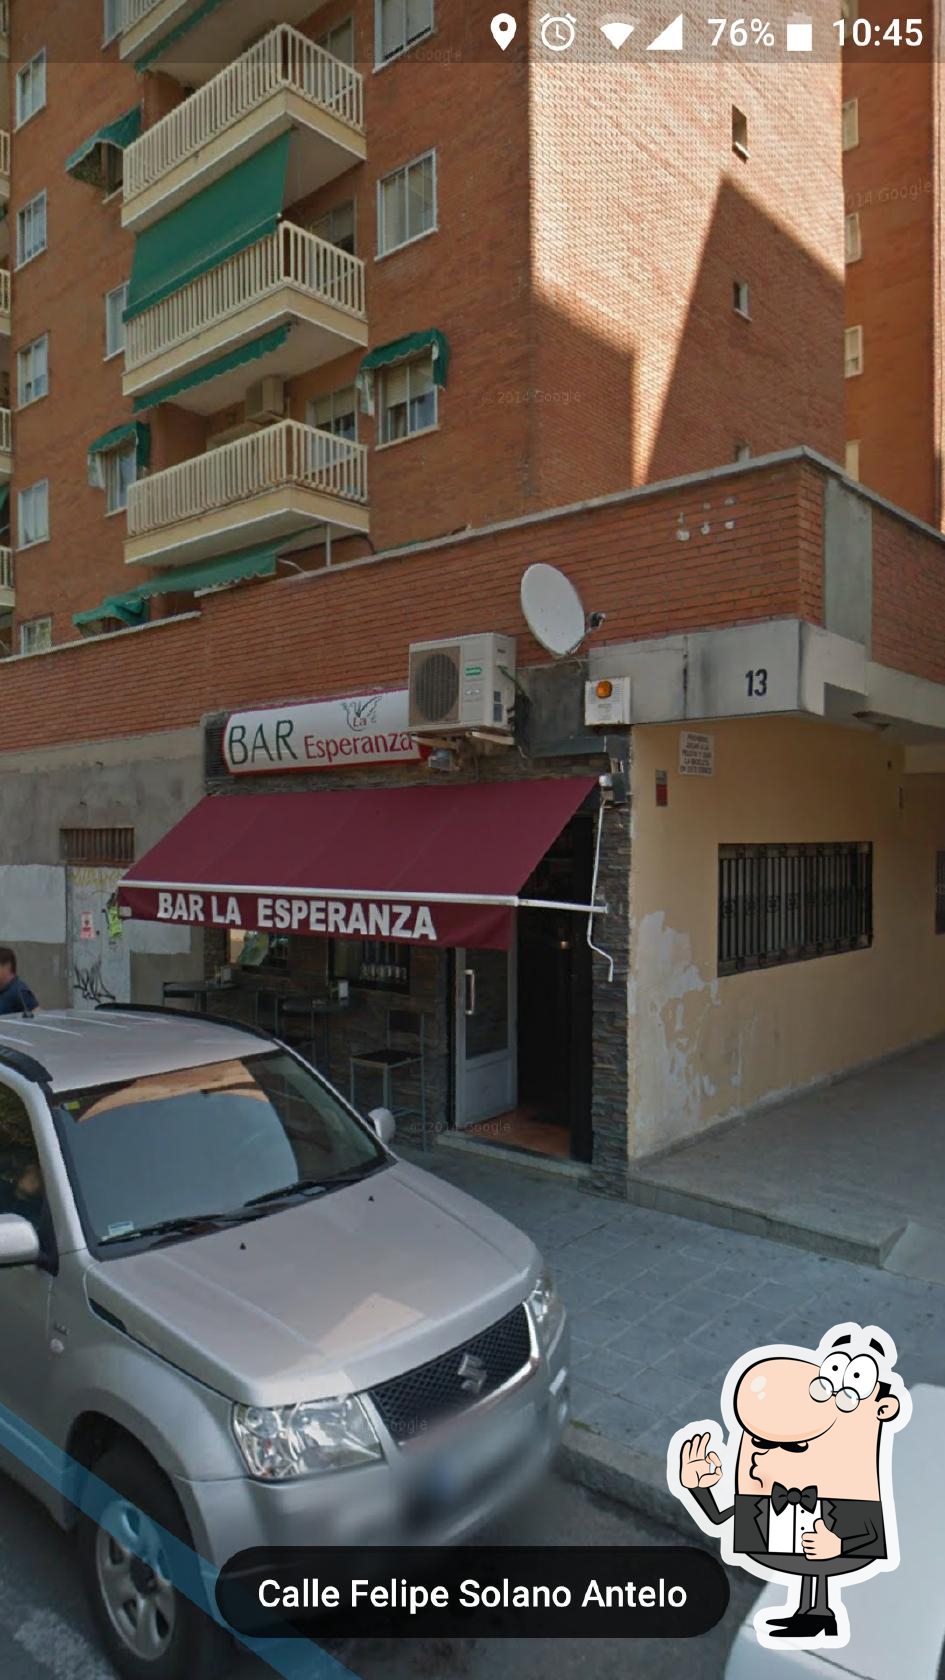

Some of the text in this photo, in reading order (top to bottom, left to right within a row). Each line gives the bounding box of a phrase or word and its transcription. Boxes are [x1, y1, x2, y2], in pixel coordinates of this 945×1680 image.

[745, 668, 768, 697] 13
[229, 719, 413, 765] BAR Esperanza
[157, 892, 437, 940] BAR LA ESPERANZA
